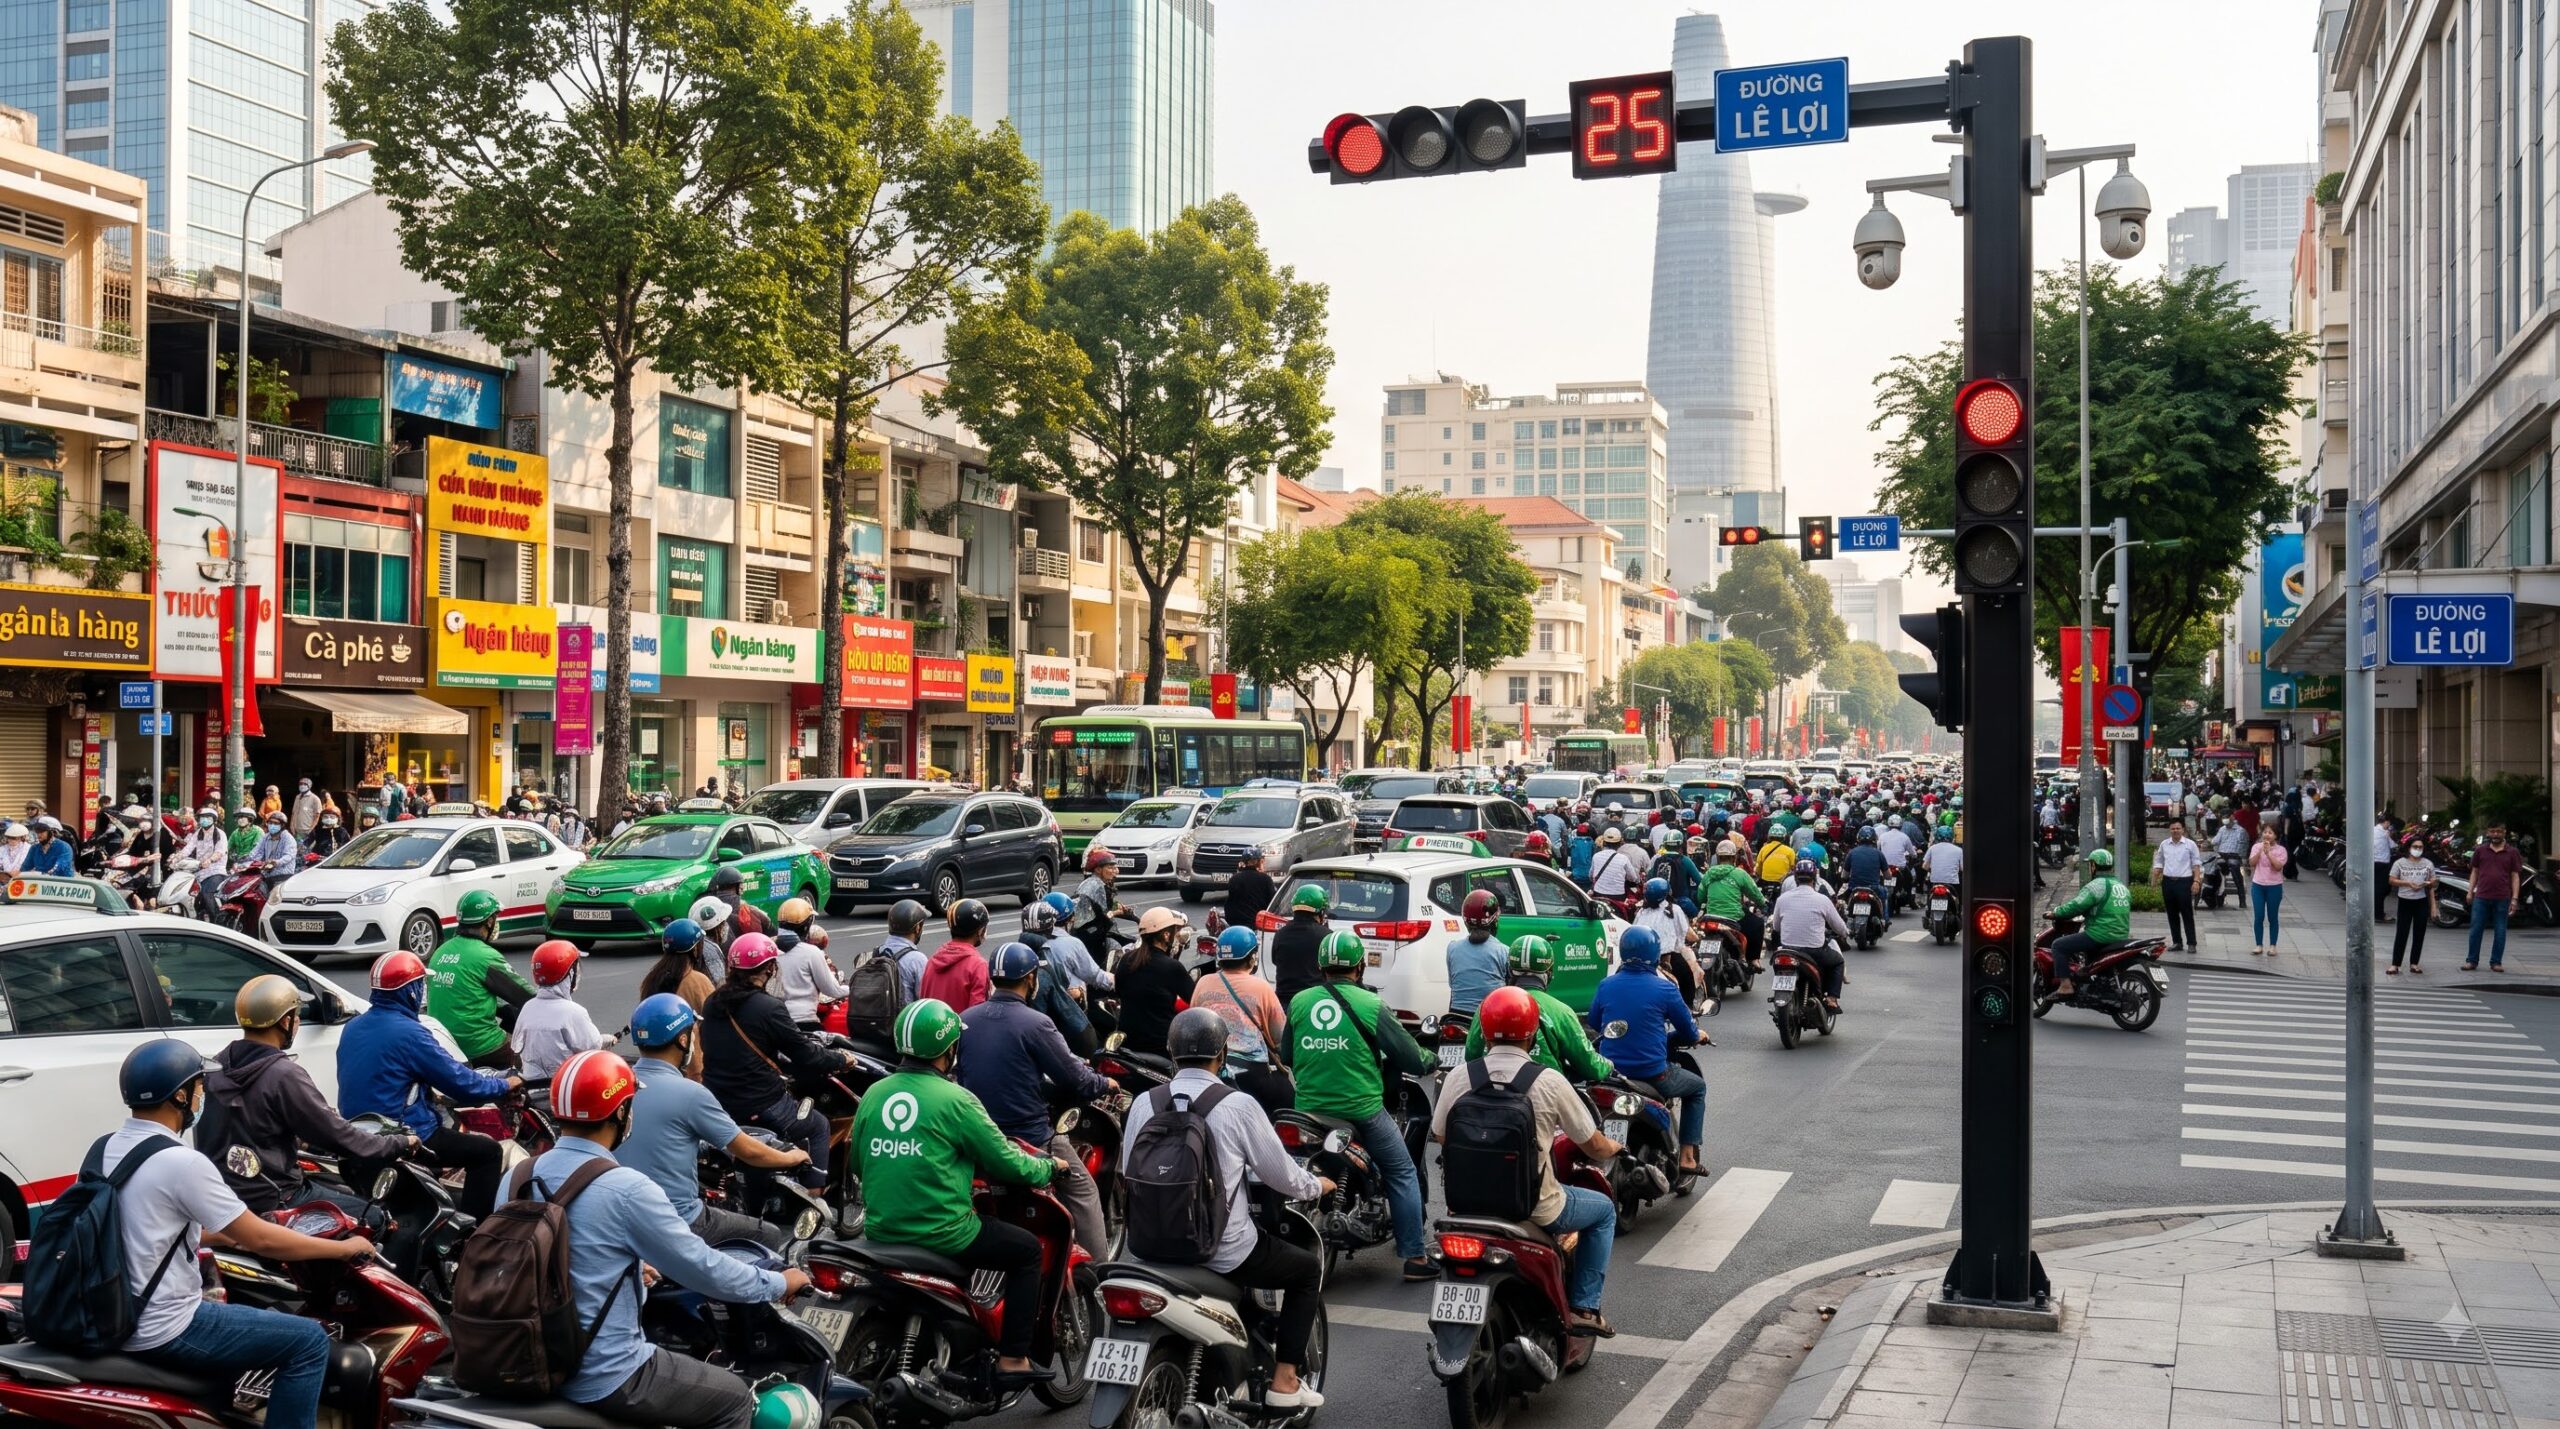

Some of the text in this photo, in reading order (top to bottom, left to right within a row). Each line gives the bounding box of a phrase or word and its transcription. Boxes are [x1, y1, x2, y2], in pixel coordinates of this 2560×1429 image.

[1739, 74, 1823, 99] ĐƯỜNG
[1586, 89, 1665, 162] 25
[1735, 100, 1828, 139] LÊ LỢI
[2415, 600, 2486, 621] ĐƯỜNG
[305, 631, 385, 667] Cà phê
[2415, 626, 2486, 660] LÊ LỢI
[870, 1137, 925, 1159] gojek
